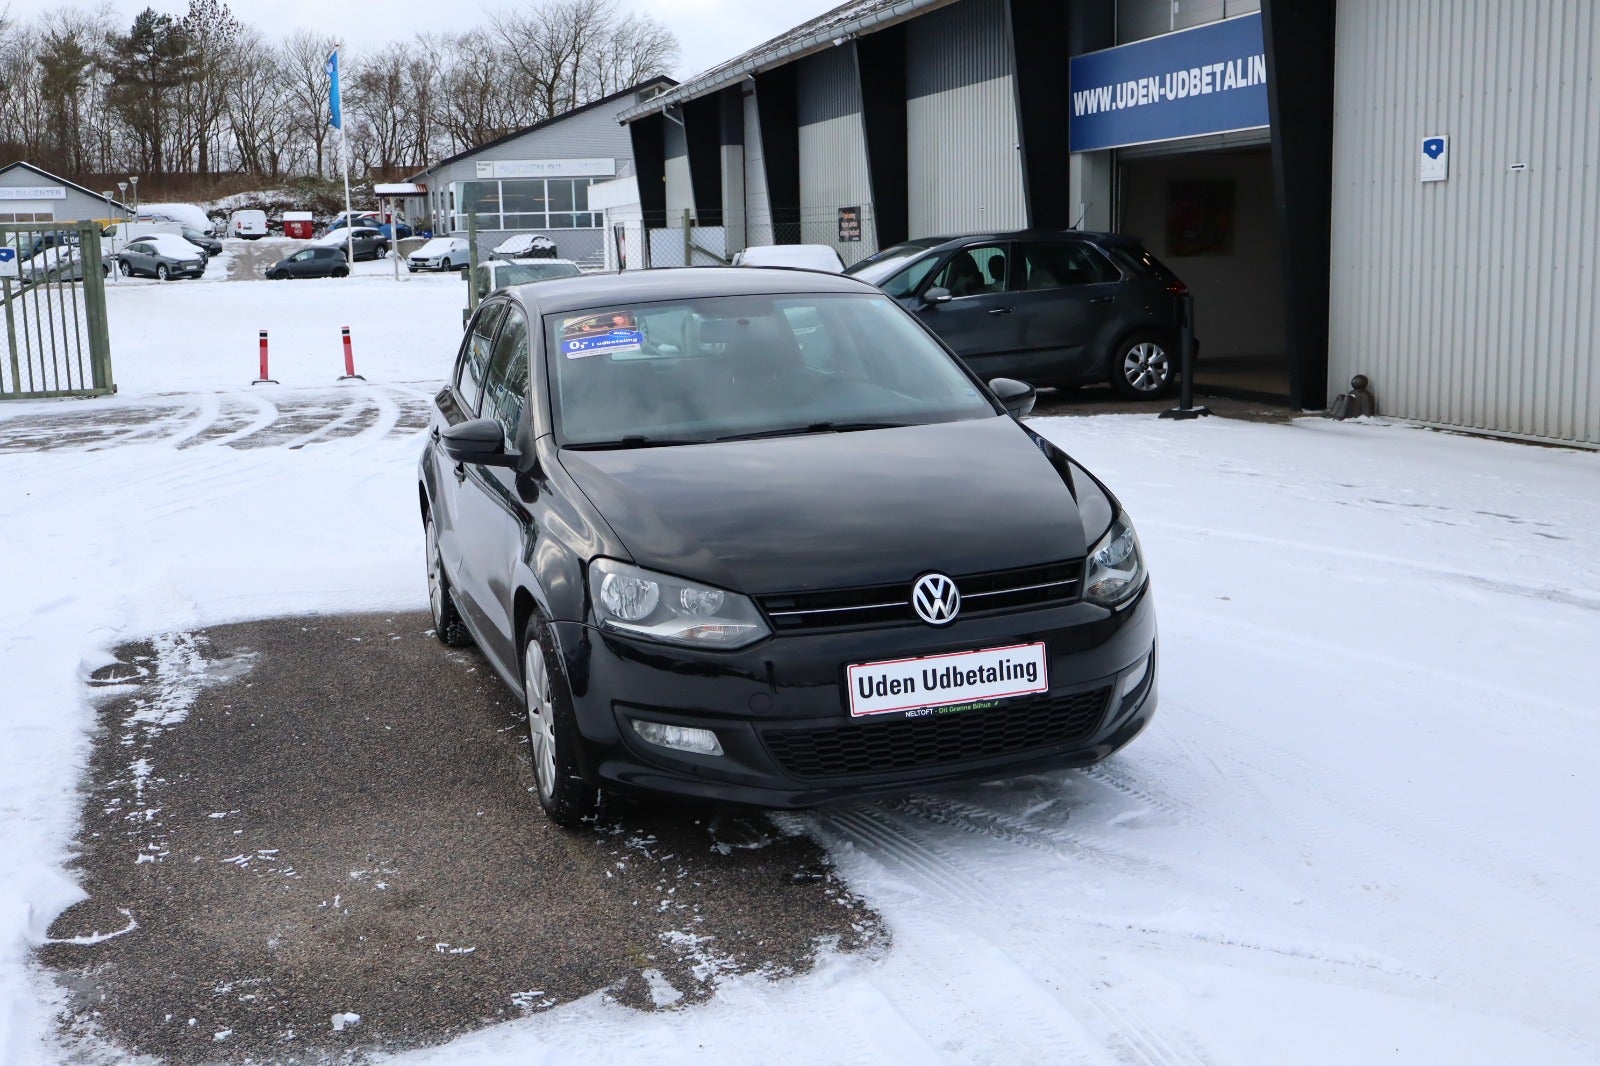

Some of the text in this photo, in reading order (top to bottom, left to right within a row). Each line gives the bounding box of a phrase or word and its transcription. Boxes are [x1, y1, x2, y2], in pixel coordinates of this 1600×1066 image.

[858, 659, 1038, 699] Uden Udbetaling
[905, 708, 934, 718] NELTOFT
[938, 706, 948, 714] Dit
